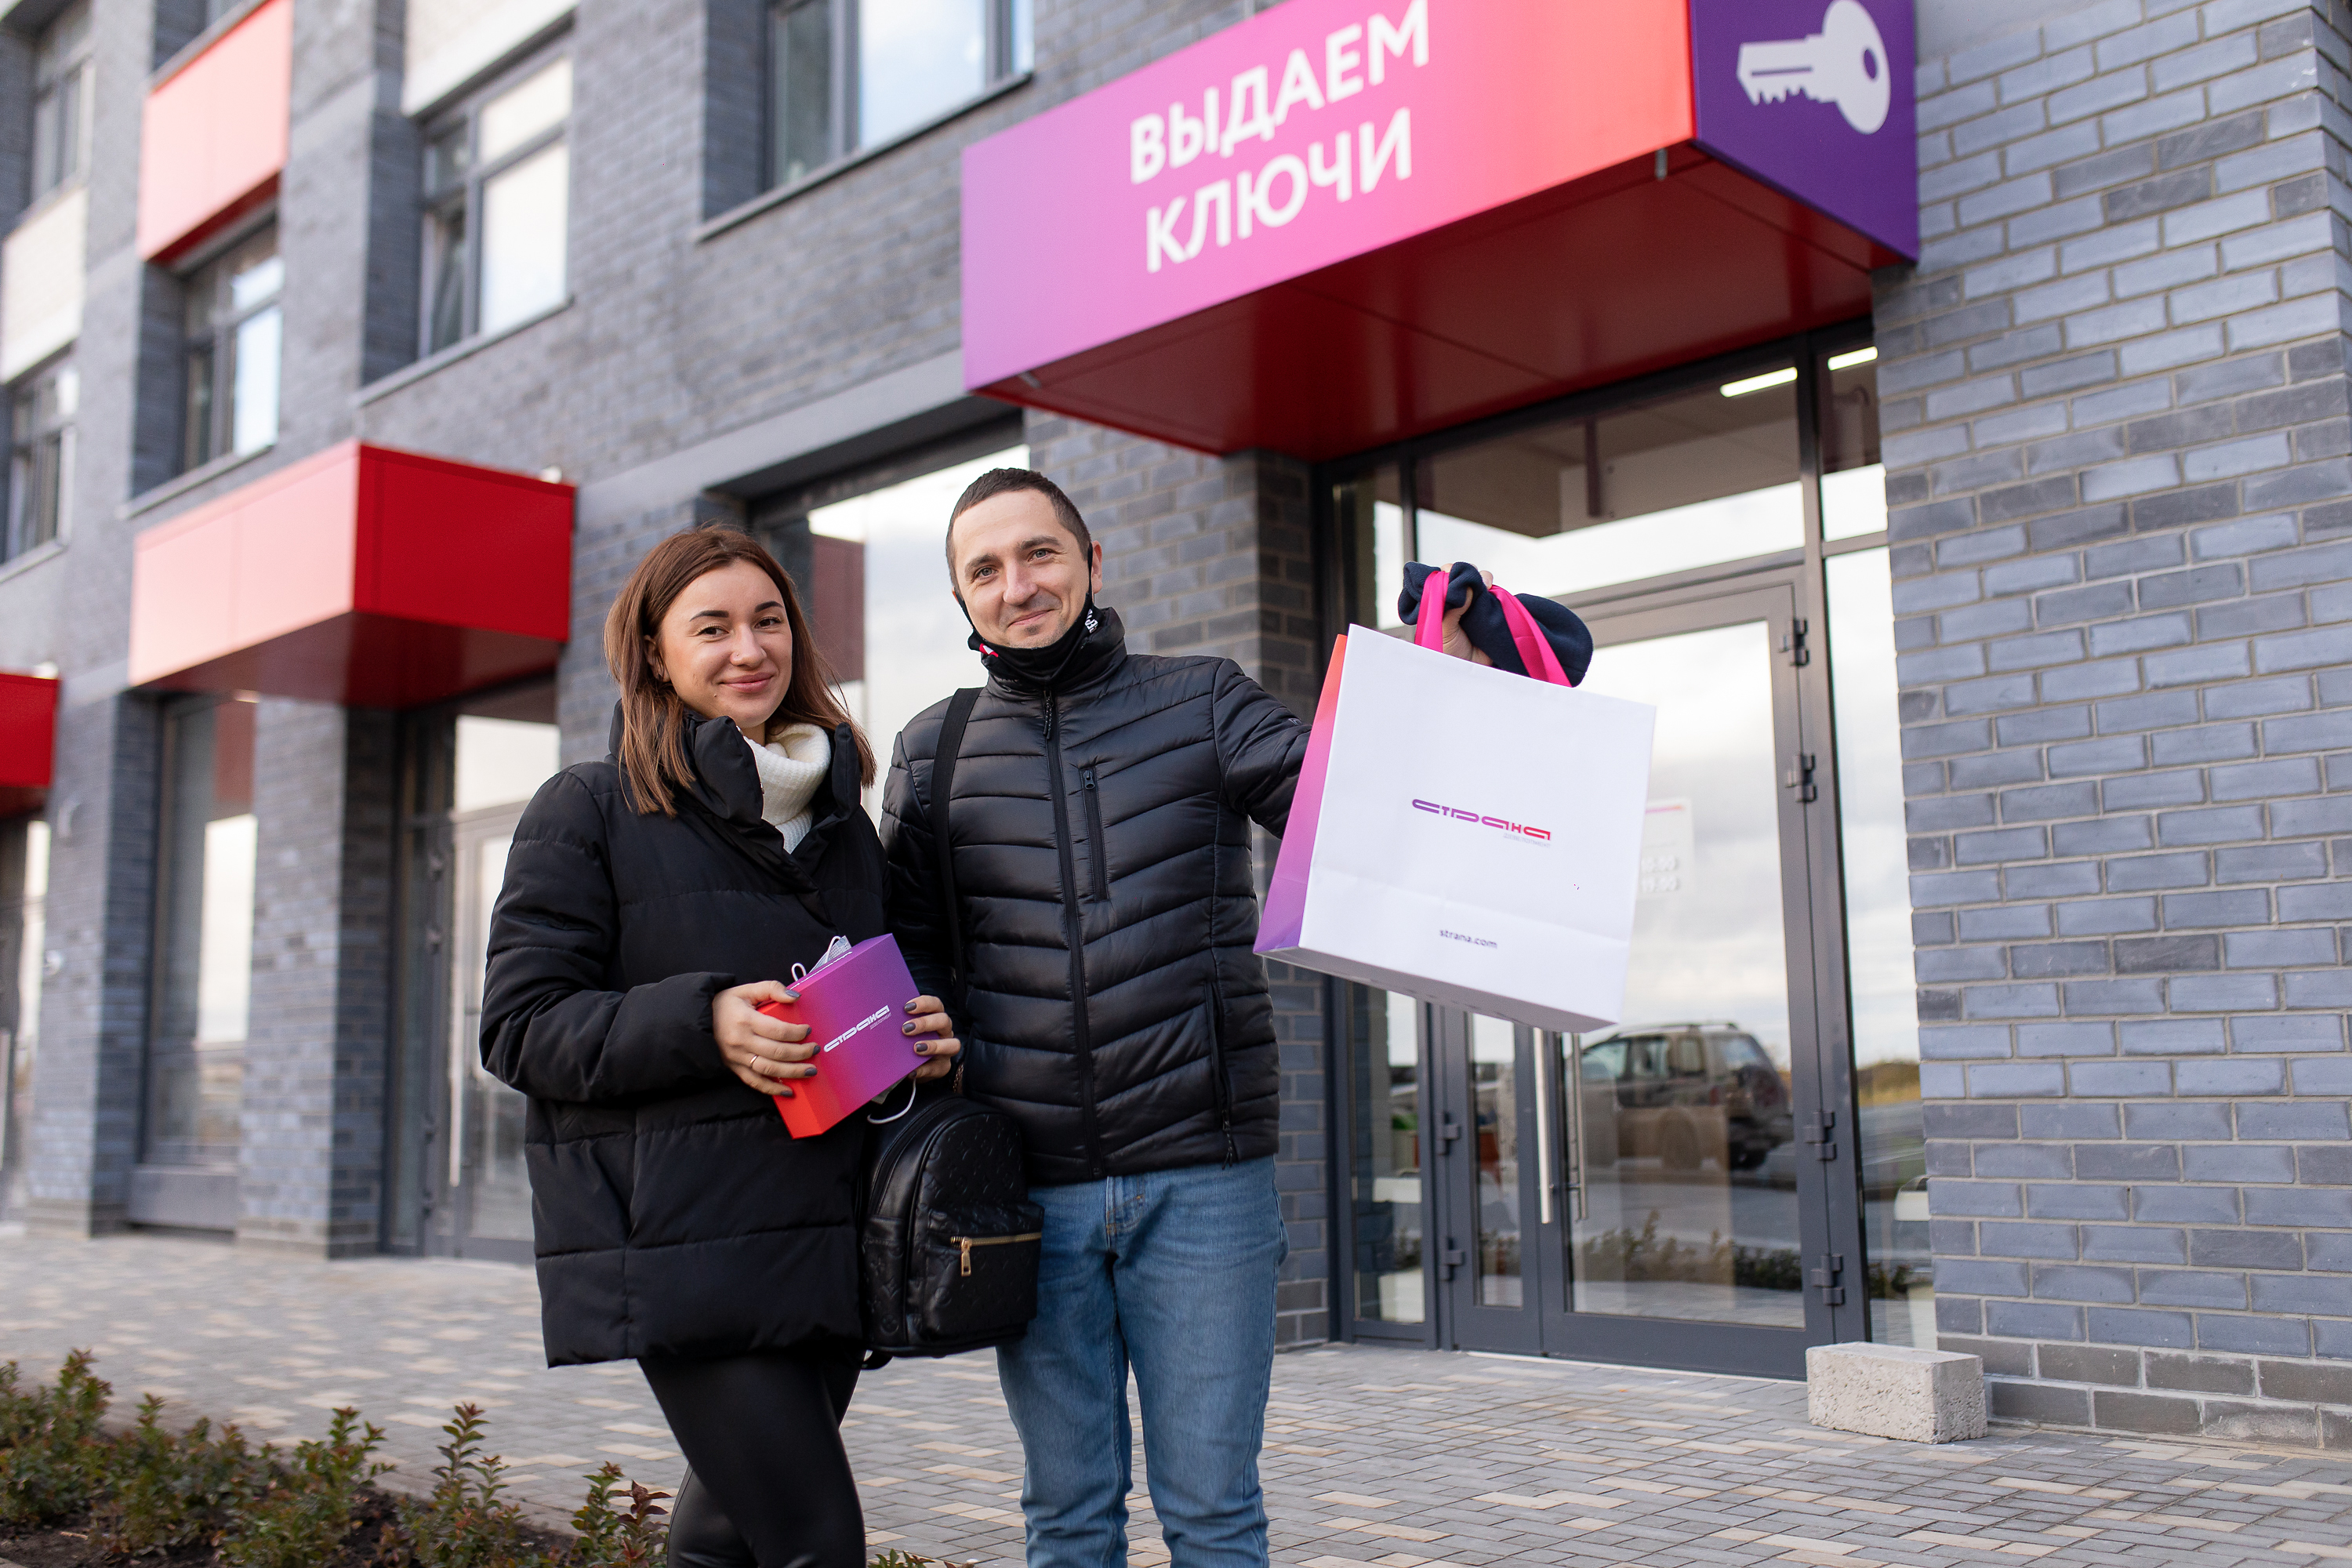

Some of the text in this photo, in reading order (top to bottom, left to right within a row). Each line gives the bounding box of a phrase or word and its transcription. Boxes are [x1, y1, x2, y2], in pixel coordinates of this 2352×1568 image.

[1130, 0, 1430, 185] ВЫДАЕМ
[1145, 107, 1412, 274] КЛЮЧИ
[1439, 928, 1498, 949] strana.com
